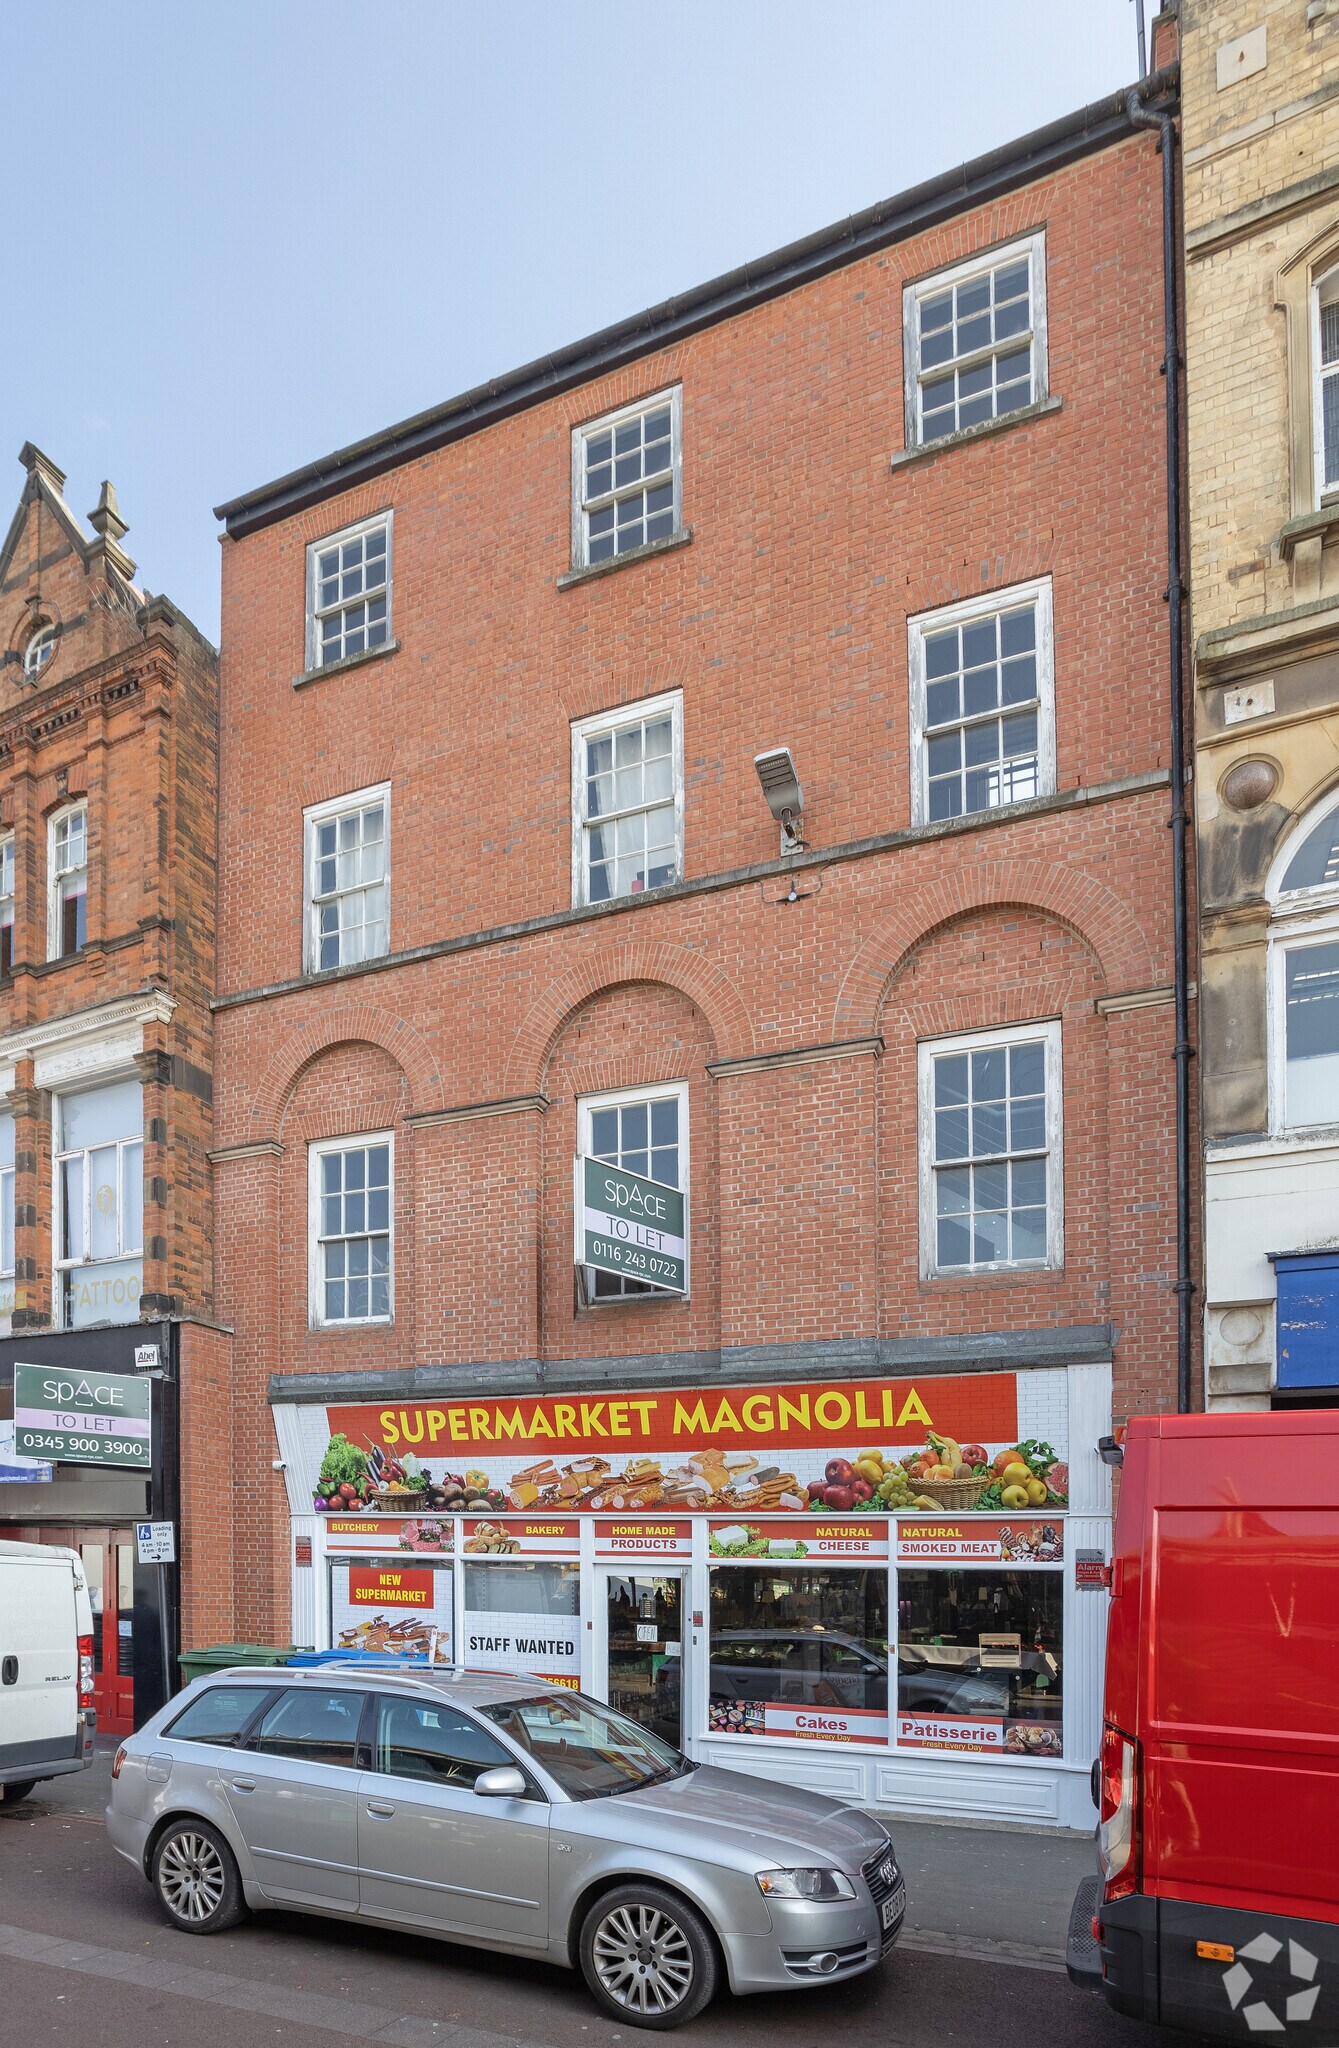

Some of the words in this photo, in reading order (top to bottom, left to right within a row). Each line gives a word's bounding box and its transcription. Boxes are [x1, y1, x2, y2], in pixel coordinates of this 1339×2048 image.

[606, 1216, 629, 1239] TO
[636, 1226, 666, 1250] LET
[593, 1240, 621, 1261] 0116
[625, 1250, 646, 1269] 243
[649, 1258, 677, 1279] 0722
[71, 1276, 140, 1308] TATTOO
[379, 1401, 658, 1444] SUPERMARKET
[673, 1387, 933, 1434] MAGNOLIA
[52, 1414, 76, 1428] TO
[84, 1417, 115, 1431] LET
[23, 1434, 64, 1449] 0345
[69, 1438, 99, 1452] 900
[104, 1441, 142, 1455] 3900
[332, 1523, 379, 1532] BUTCHERY
[525, 1526, 565, 1534] BAKERY
[612, 1526, 643, 1535] HOME
[645, 1526, 676, 1535] MADE
[816, 1527, 873, 1537] NATURAL
[902, 1527, 963, 1537] NATURAL
[611, 1539, 677, 1549] PRODUCTS
[818, 1541, 870, 1551] CHEESE
[902, 1543, 956, 1553] SMOKED
[961, 1543, 998, 1553] MEAT
[379, 1574, 402, 1586] NEW
[355, 1588, 427, 1602] SUPERMARKET
[638, 1626, 656, 1640] OPEN
[469, 1636, 510, 1652] STAFF
[515, 1639, 574, 1656] WANTED
[795, 1715, 848, 1731] Cakes
[795, 1731, 814, 1739] Fresh
[816, 1732, 836, 1741] Every
[837, 1734, 851, 1742] Day
[902, 1722, 998, 1741] Patisserie
[922, 1740, 942, 1748] Fresh
[944, 1742, 966, 1751] Every
[967, 1744, 983, 1752] Day
